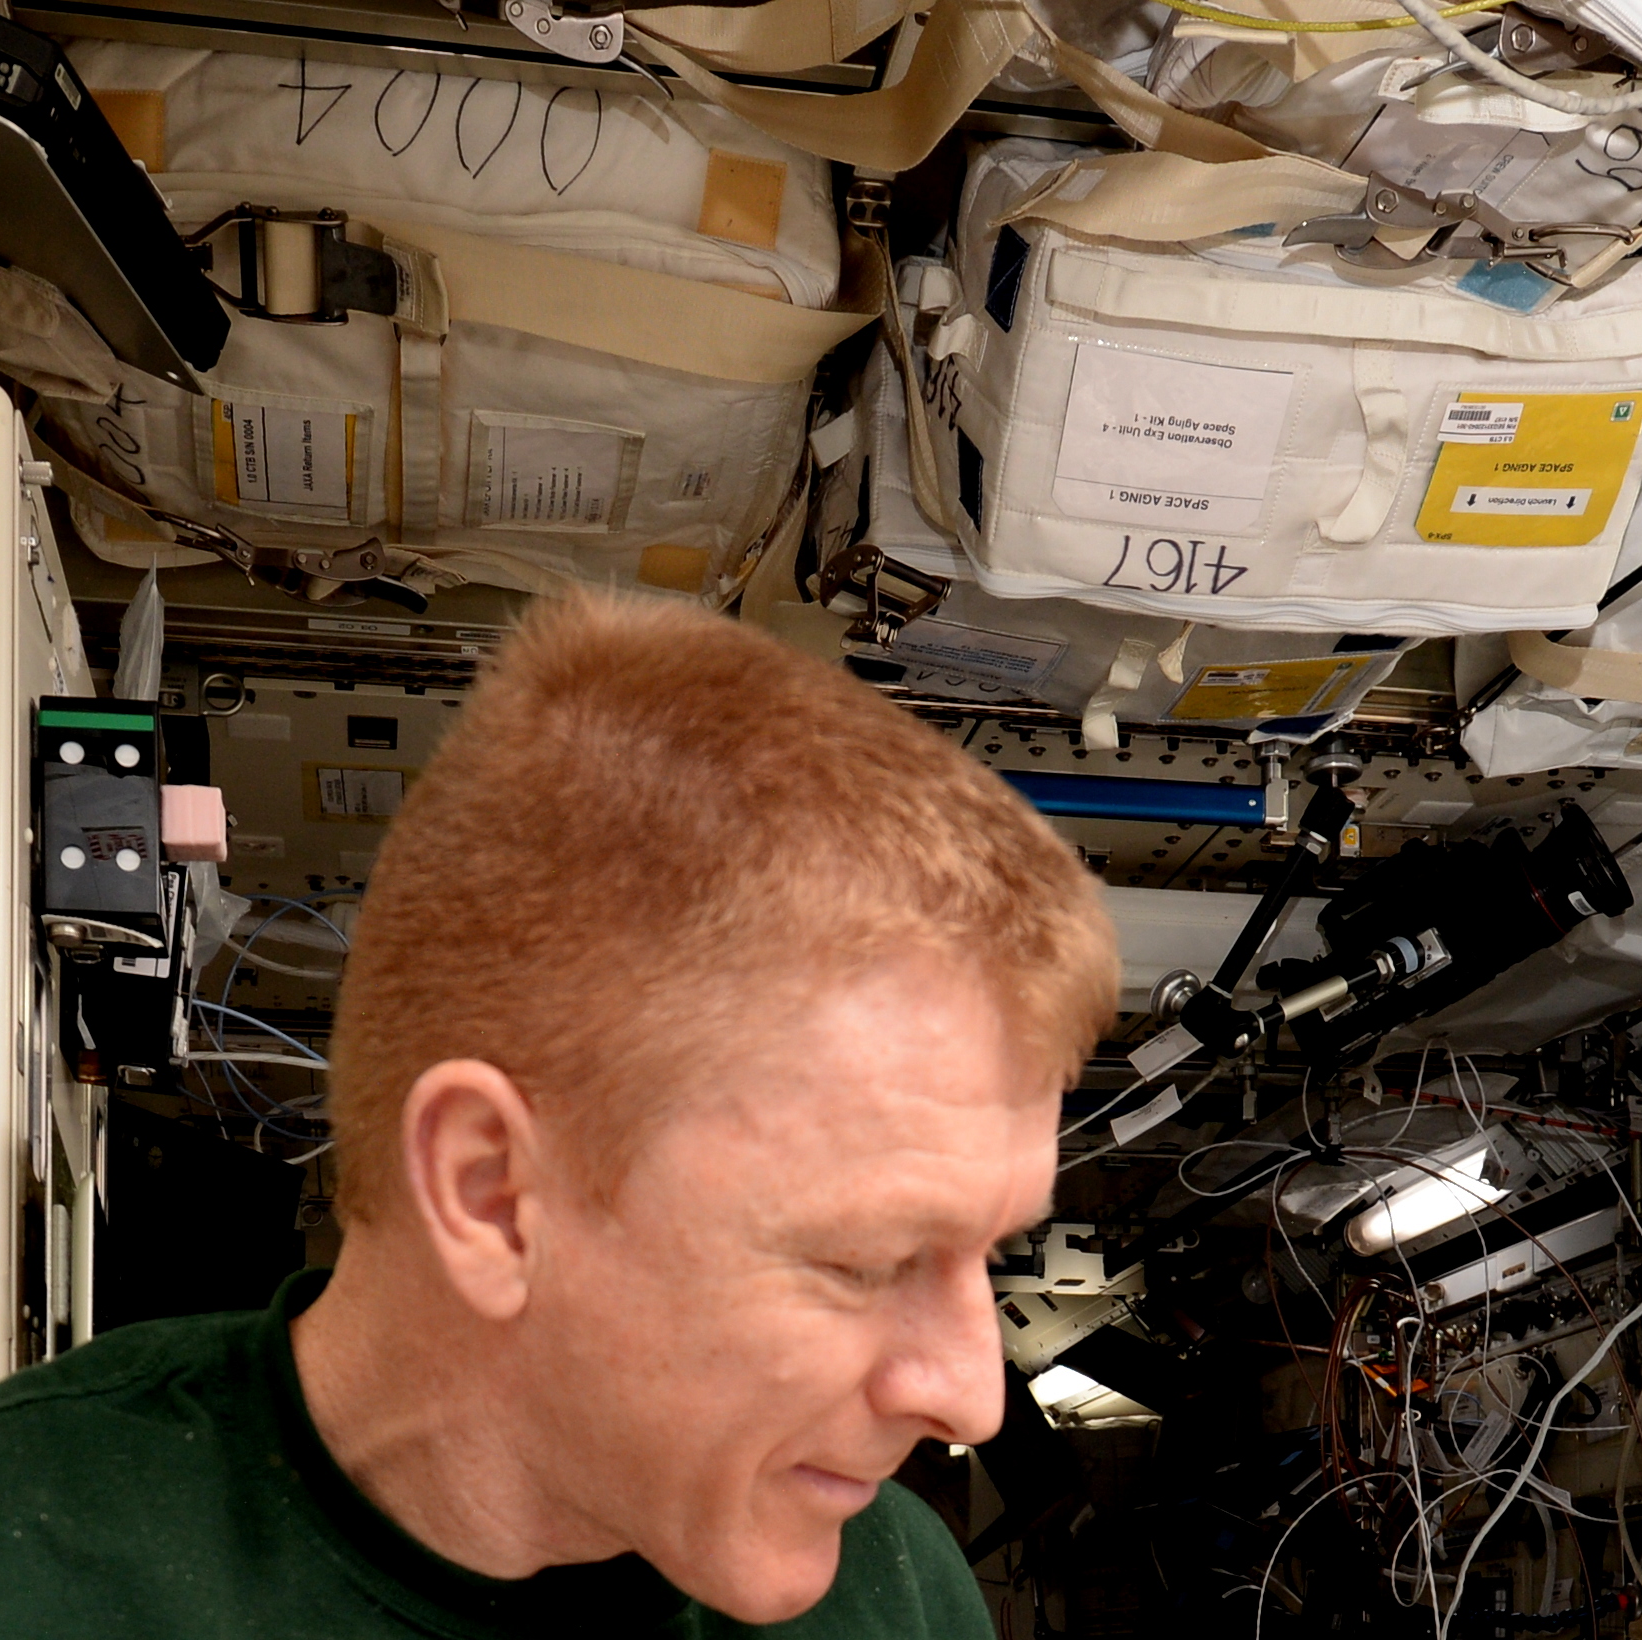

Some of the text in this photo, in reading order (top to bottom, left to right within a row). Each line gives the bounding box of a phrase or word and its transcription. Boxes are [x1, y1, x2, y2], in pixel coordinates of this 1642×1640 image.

[279, 59, 601, 195] 0004
[243, 418, 254, 438] 0004
[1134, 413, 1236, 436] Space Aging Kit 1
[1102, 423, 1233, 449] Observation Exp Unit 4
[302, 419, 314, 491] JAXA Return Items
[1501, 462, 1537, 473] AGING
[1538, 463, 1574, 473] SPACE
[1109, 489, 1210, 510] SPACE AGING 1
[1487, 496, 1557, 506] Launch Direction
[1102, 535, 1249, 595] 4167
